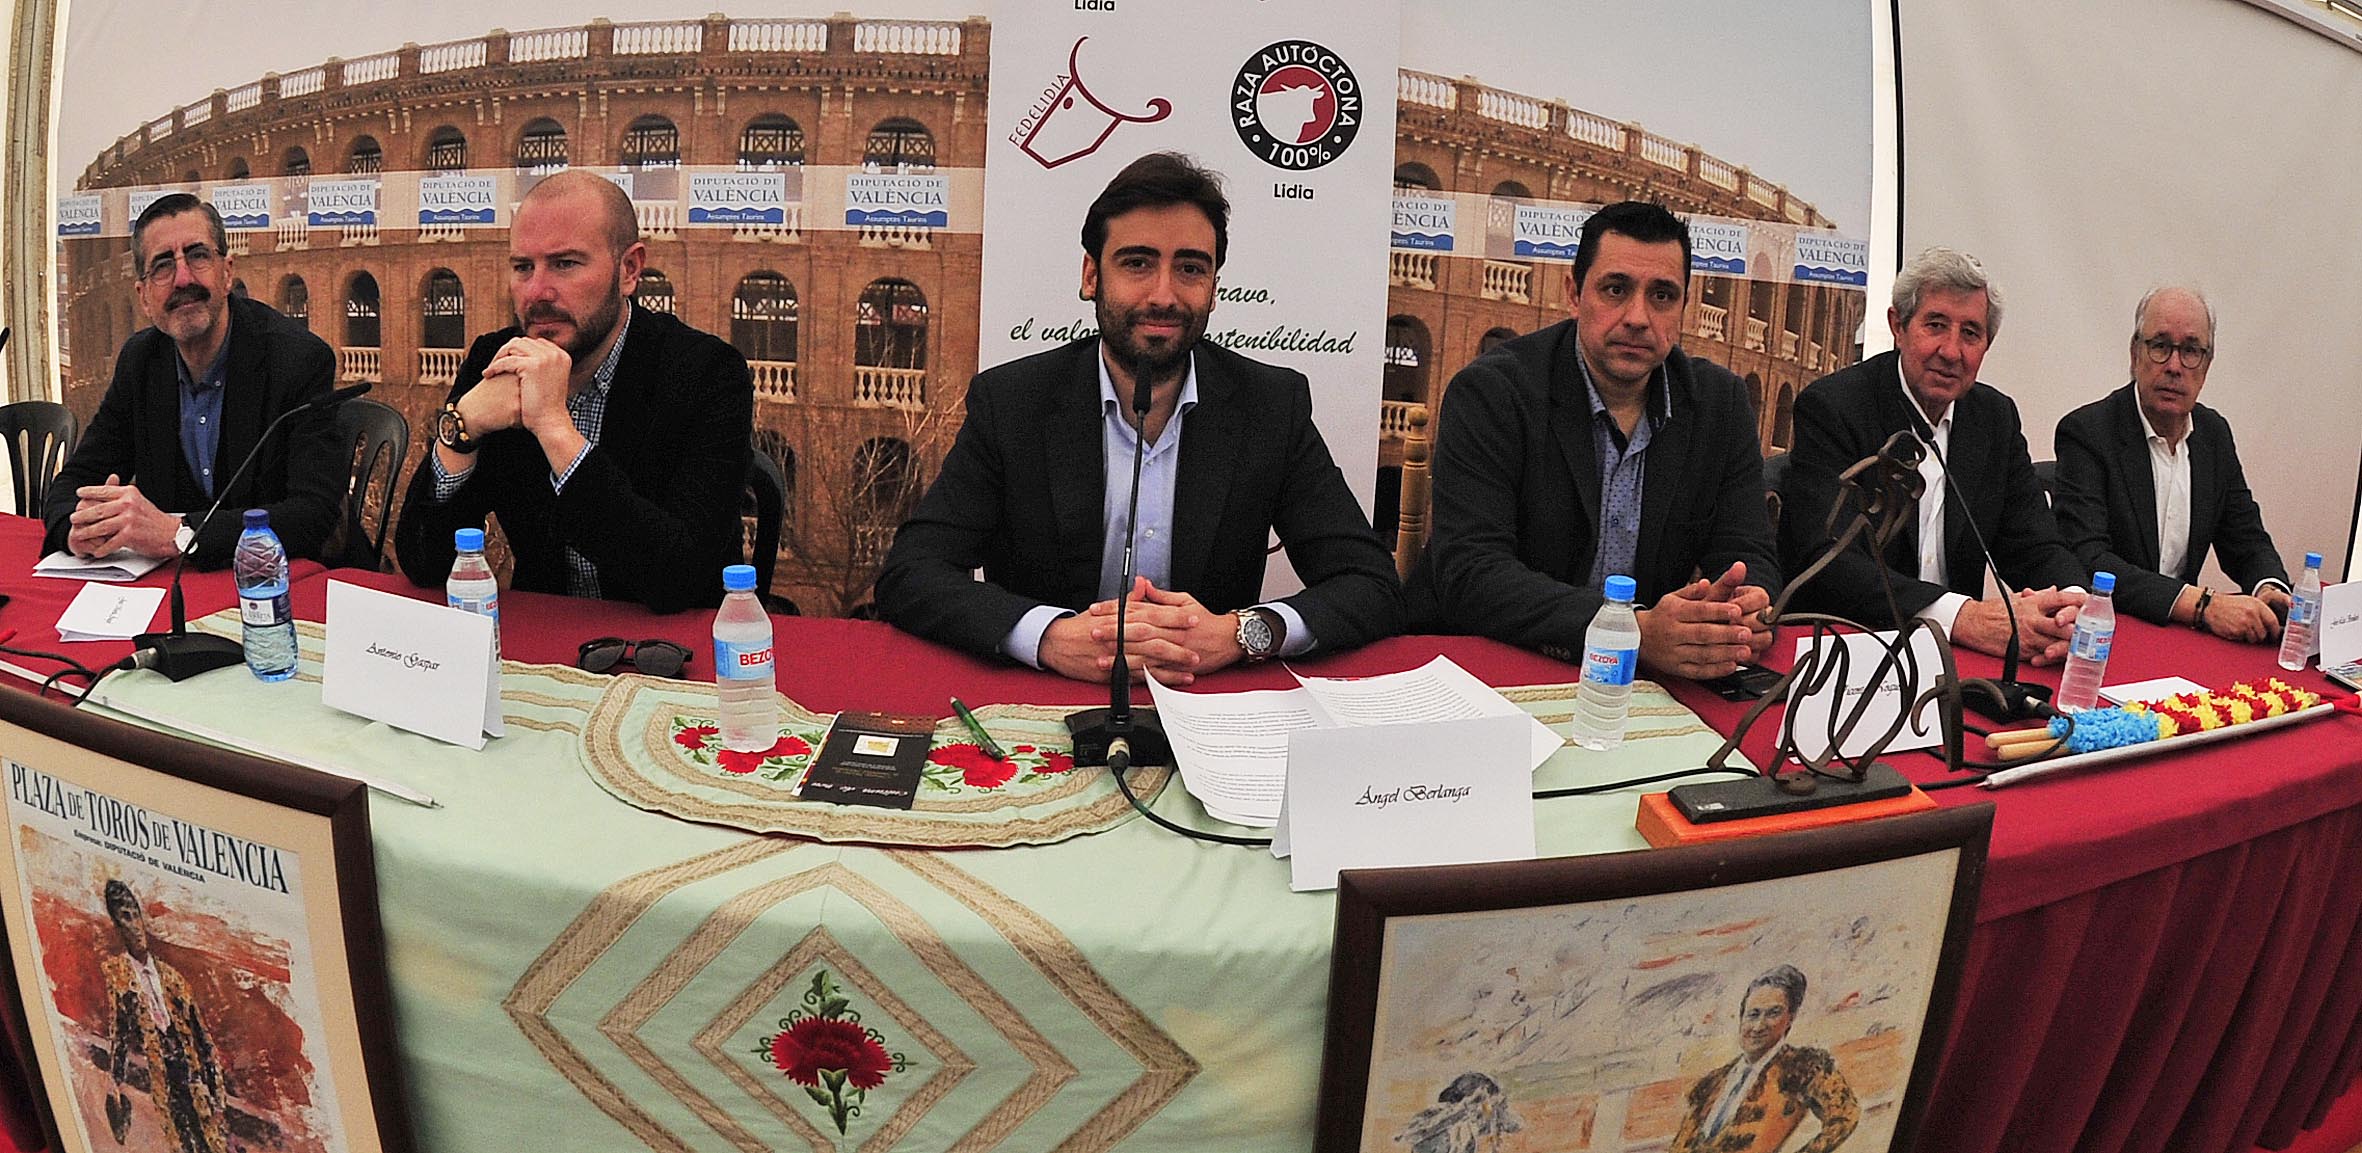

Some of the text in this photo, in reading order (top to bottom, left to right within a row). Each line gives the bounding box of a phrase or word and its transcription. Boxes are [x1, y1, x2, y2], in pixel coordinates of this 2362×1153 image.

[1236, 45, 1358, 128] RAZA AUTÓCTONA
[1008, 74, 1070, 146] FEDELIDIA
[1269, 142, 1331, 167] 100%
[764, 178, 778, 186] DE
[926, 179, 943, 188] DE
[1274, 184, 1314, 199] Lidia
[1392, 200, 1429, 212] TACIÓ
[1393, 210, 1449, 229] ÈNCIA
[1520, 222, 1583, 239] VALÈNC
[1216, 282, 1275, 304] ravo,
[1010, 317, 1033, 340] el
[1203, 325, 1357, 354] ostenibilidad
[1403, 784, 1471, 803] Berlanga
[11, 763, 289, 894] PLAZA DE TOROS DE VALENCIA
[148, 857, 160, 868] DE
